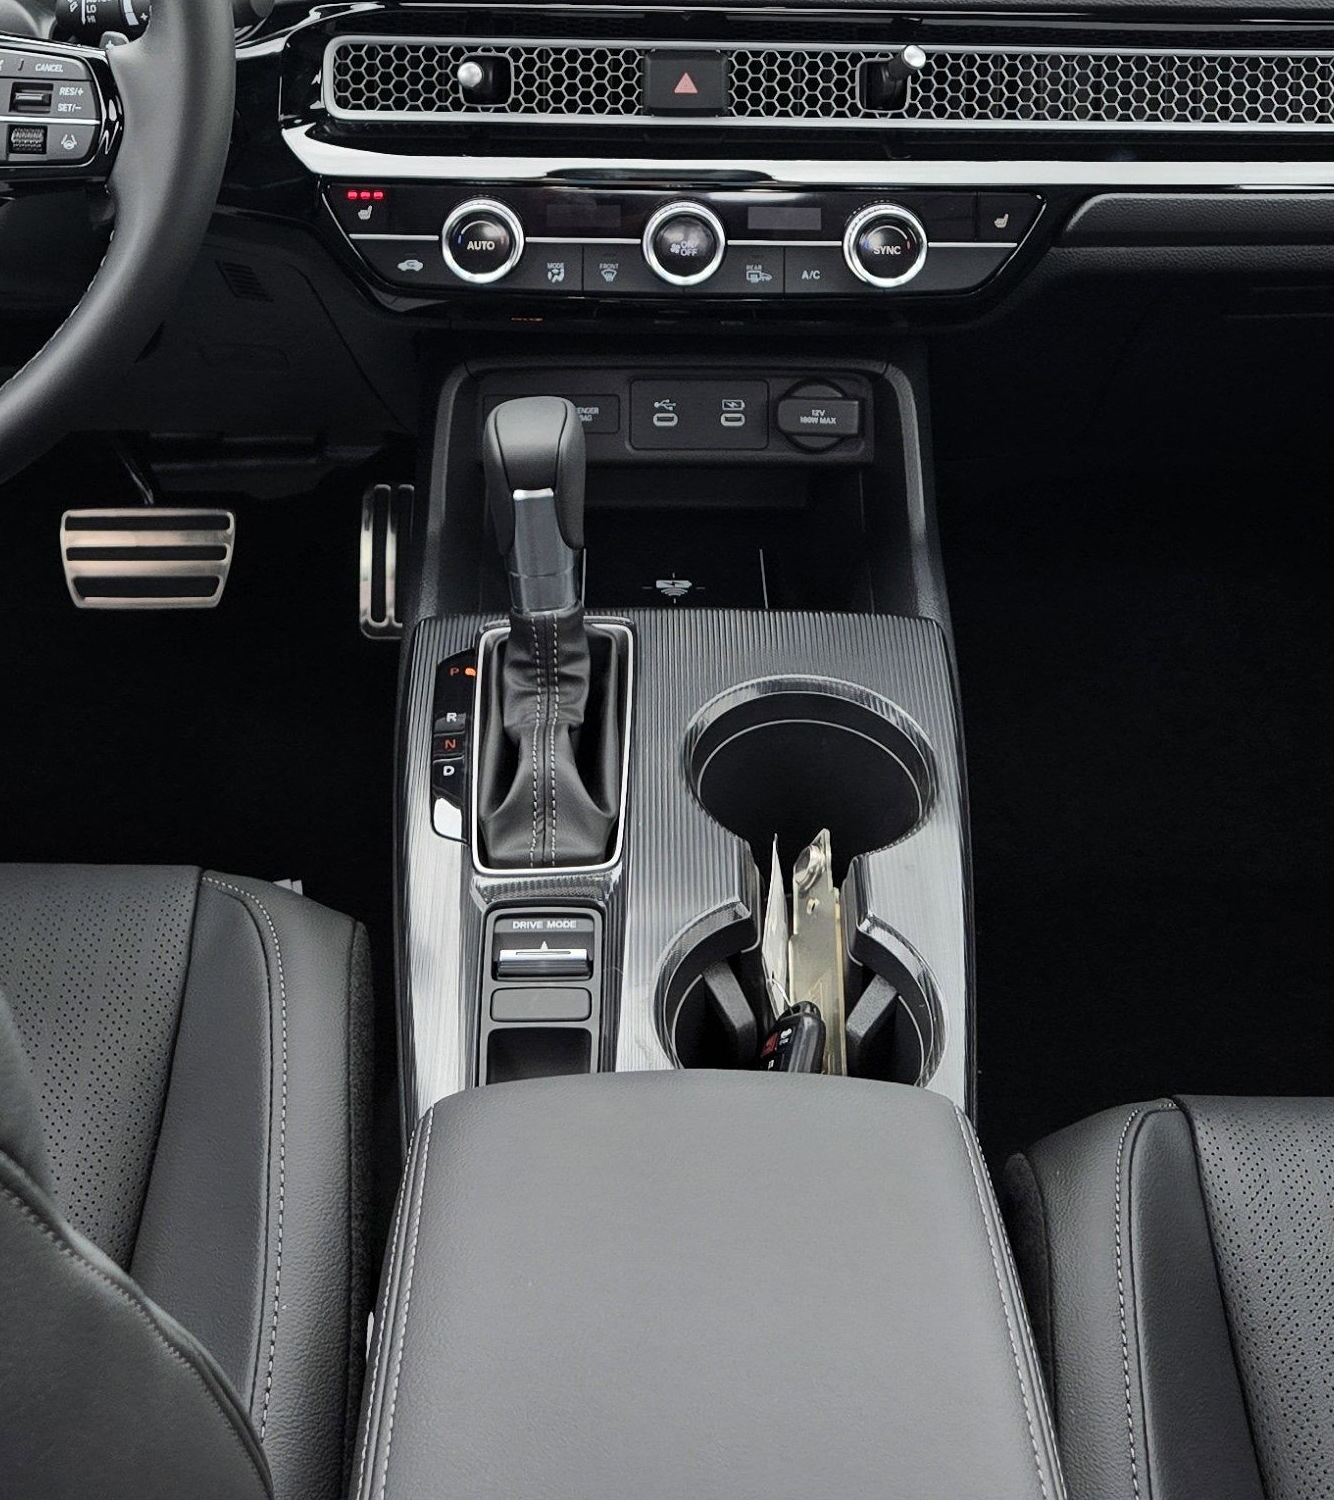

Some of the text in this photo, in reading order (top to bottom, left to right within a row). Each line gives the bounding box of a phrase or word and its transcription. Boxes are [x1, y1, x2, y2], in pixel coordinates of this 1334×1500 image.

[86, 4, 97, 13] LO
[35, 62, 64, 73] CANCEL
[59, 86, 85, 97] RES/+
[467, 240, 902, 255] AUTO SYNC
[681, 249, 698, 257] OFF
[801, 270, 821, 280] A/C
[450, 667, 460, 677] P
[446, 712, 457, 722] R
[444, 740, 456, 749] N
[443, 765, 455, 776] D
[512, 920, 576, 929] DRIVE MODE
